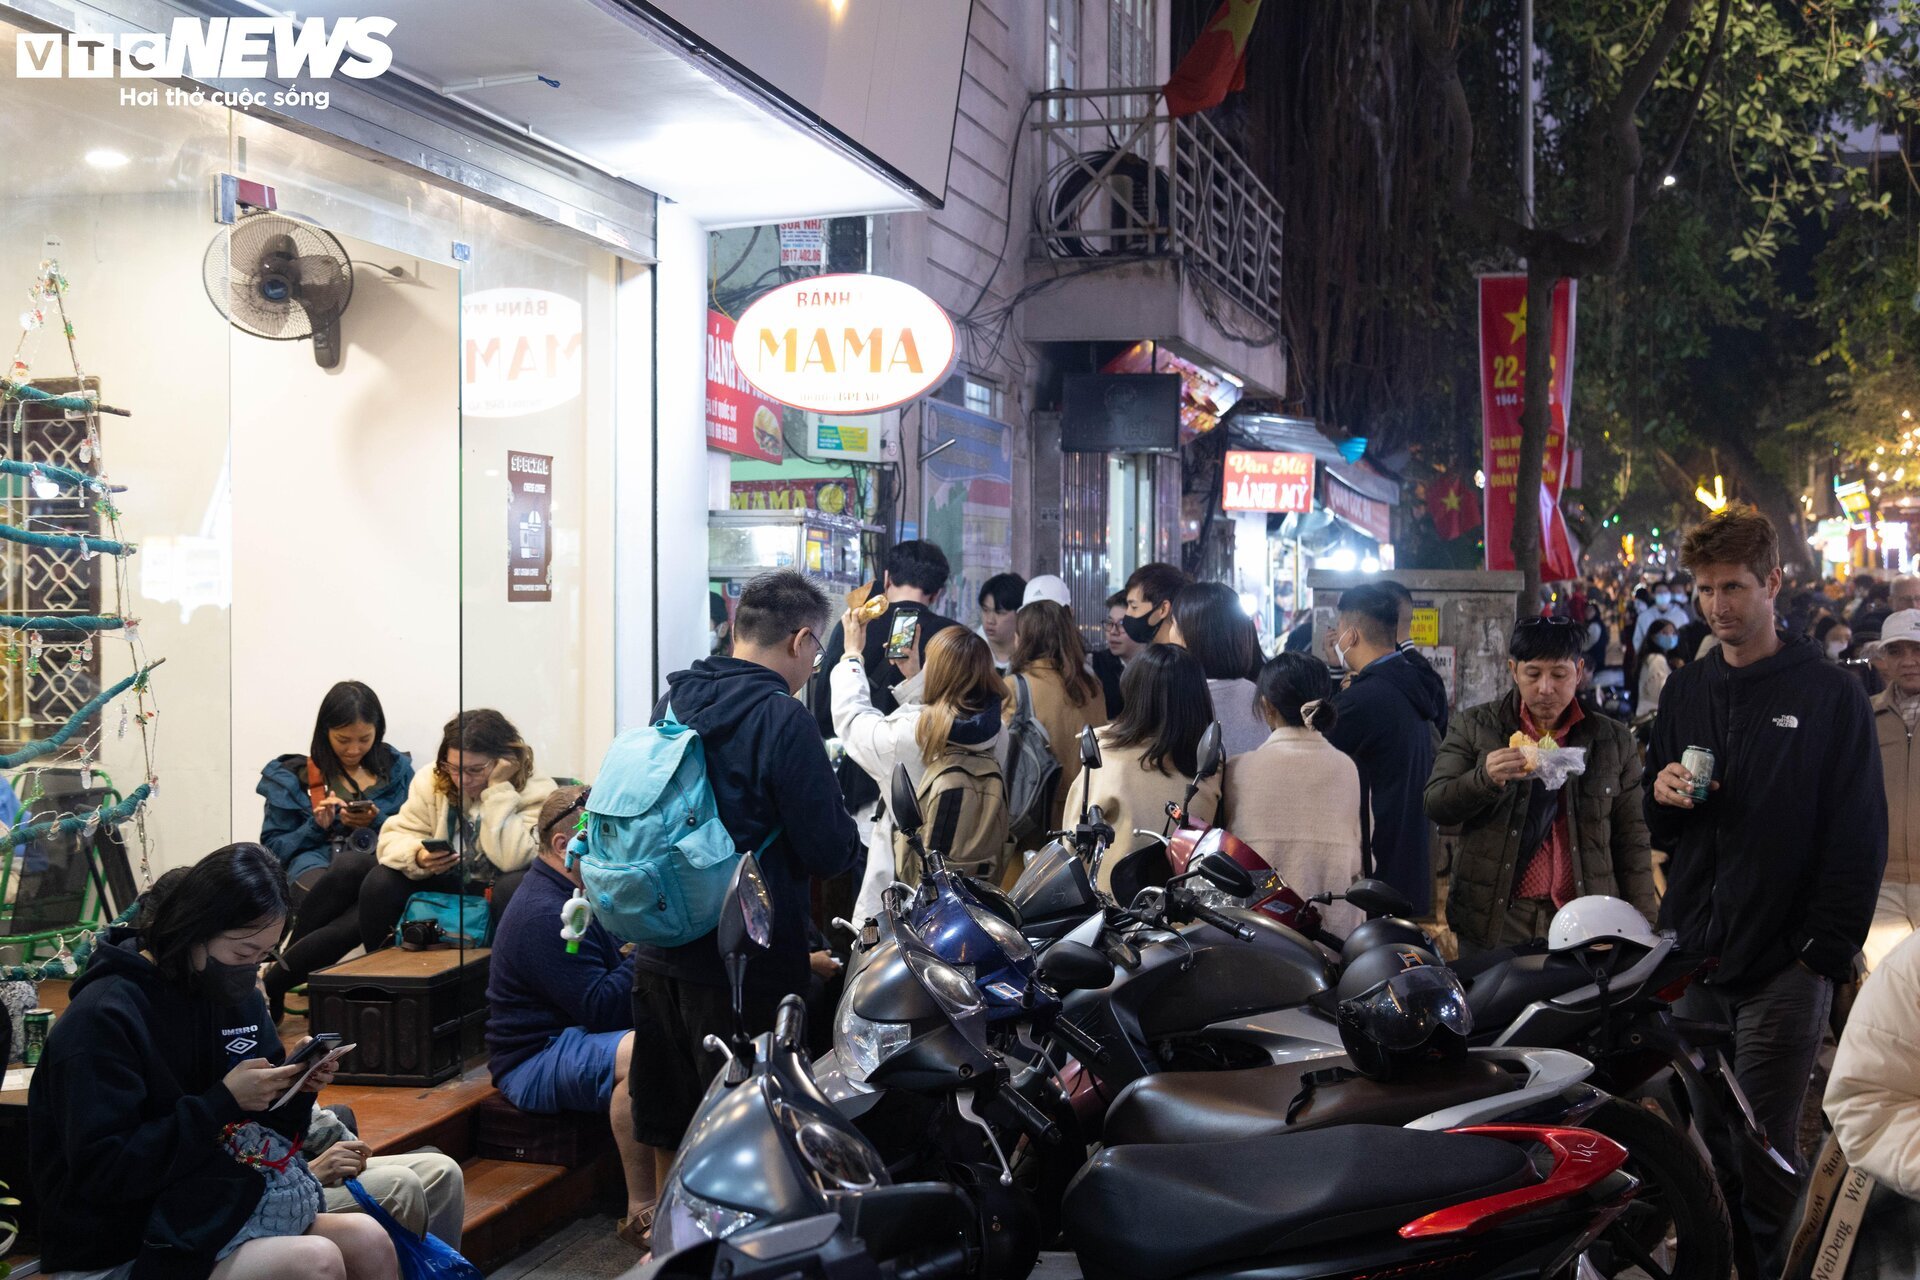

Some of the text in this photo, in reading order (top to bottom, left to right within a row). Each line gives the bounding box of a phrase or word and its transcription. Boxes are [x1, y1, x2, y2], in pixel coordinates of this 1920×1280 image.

[758, 327, 924, 374] MAMA
[1494, 355, 1518, 389] 22
[511, 454, 550, 475] SPECIAL
[730, 489, 807, 510] MAMA
[1225, 474, 1278, 508] BÁNH
[222, 1025, 258, 1036] UMBRO
